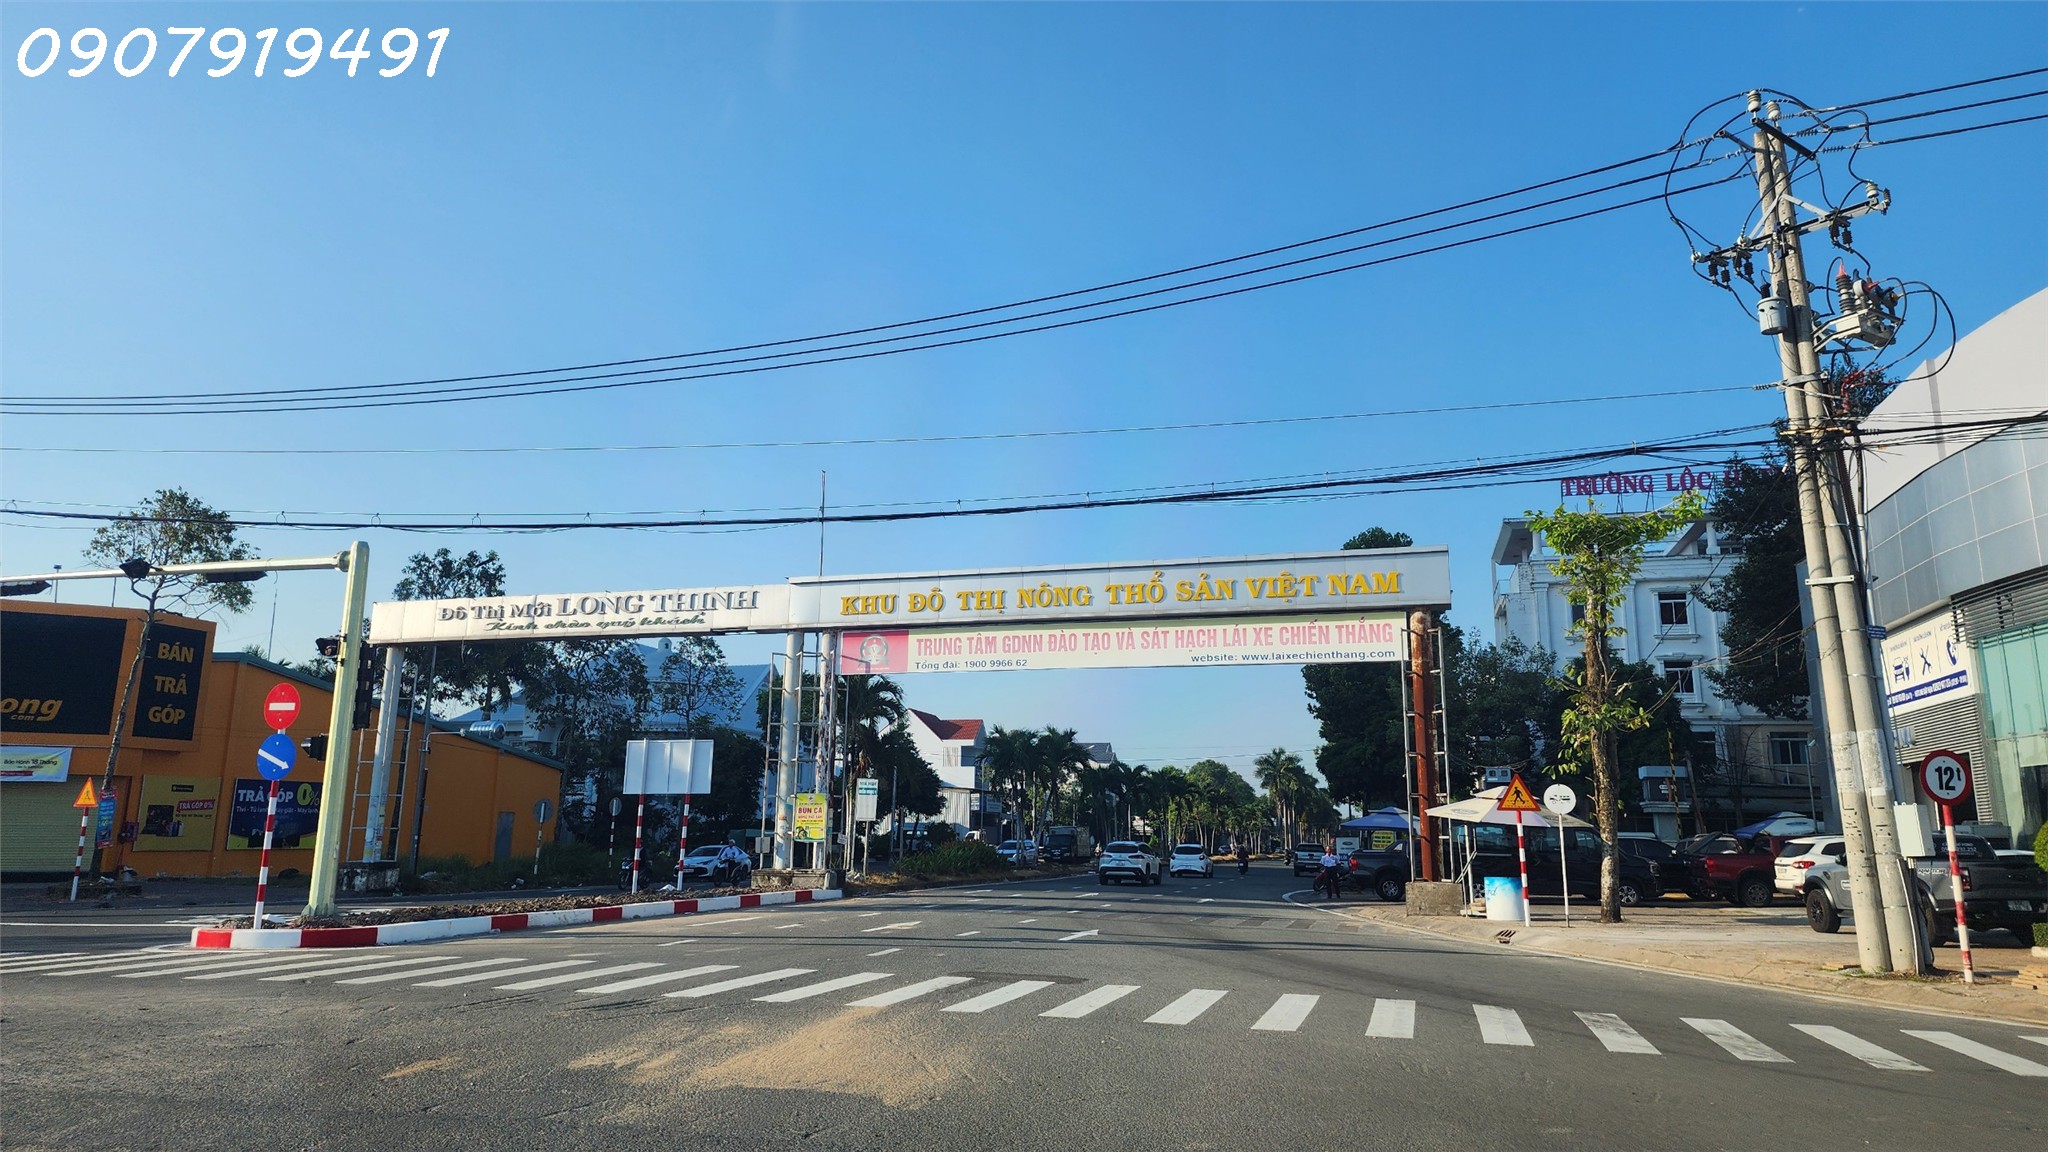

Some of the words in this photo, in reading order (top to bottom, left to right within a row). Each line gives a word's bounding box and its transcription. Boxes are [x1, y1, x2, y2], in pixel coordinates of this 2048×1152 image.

[840, 594, 897, 615] KHU
[908, 587, 944, 612] ĐÔ
[956, 588, 1006, 614] THỊ
[1017, 582, 1092, 608] NÔNG
[1105, 570, 1165, 604] THỔ
[1176, 573, 1235, 602] SẢN
[1244, 571, 1318, 602] VIỆT
[1327, 571, 1401, 596] NAM
[438, 604, 468, 621] Đô
[470, 602, 505, 622] Thị
[510, 602, 553, 618] Mới
[556, 594, 645, 617] LONG
[916, 637, 962, 657] TRUNG
[967, 632, 998, 655] TÂM
[1003, 633, 1044, 655] GDNN
[1048, 629, 1078, 652] ĐÀO
[1084, 631, 1111, 656] TẠO
[1115, 626, 1136, 650] VÀ
[1140, 626, 1169, 649] SÁT
[1175, 627, 1217, 653] HẠCH
[1223, 623, 1248, 647] LÁI
[1253, 626, 1273, 647] XE
[1279, 618, 1330, 645] CHIẾN
[1335, 616, 1394, 645] THẮNG
[158, 641, 194, 664] BÁN
[1191, 652, 1237, 662] website:
[1241, 650, 1395, 662] www.laixechienthang.com
[915, 659, 940, 670] Tổng
[943, 659, 960, 669] đài:
[964, 660, 987, 668] 1900
[989, 659, 1012, 668] 9966
[1015, 659, 1028, 667] 62
[154, 673, 188, 695] TRẢ
[148, 704, 186, 725] GÓP
[238, 785, 264, 803] TRẢ
